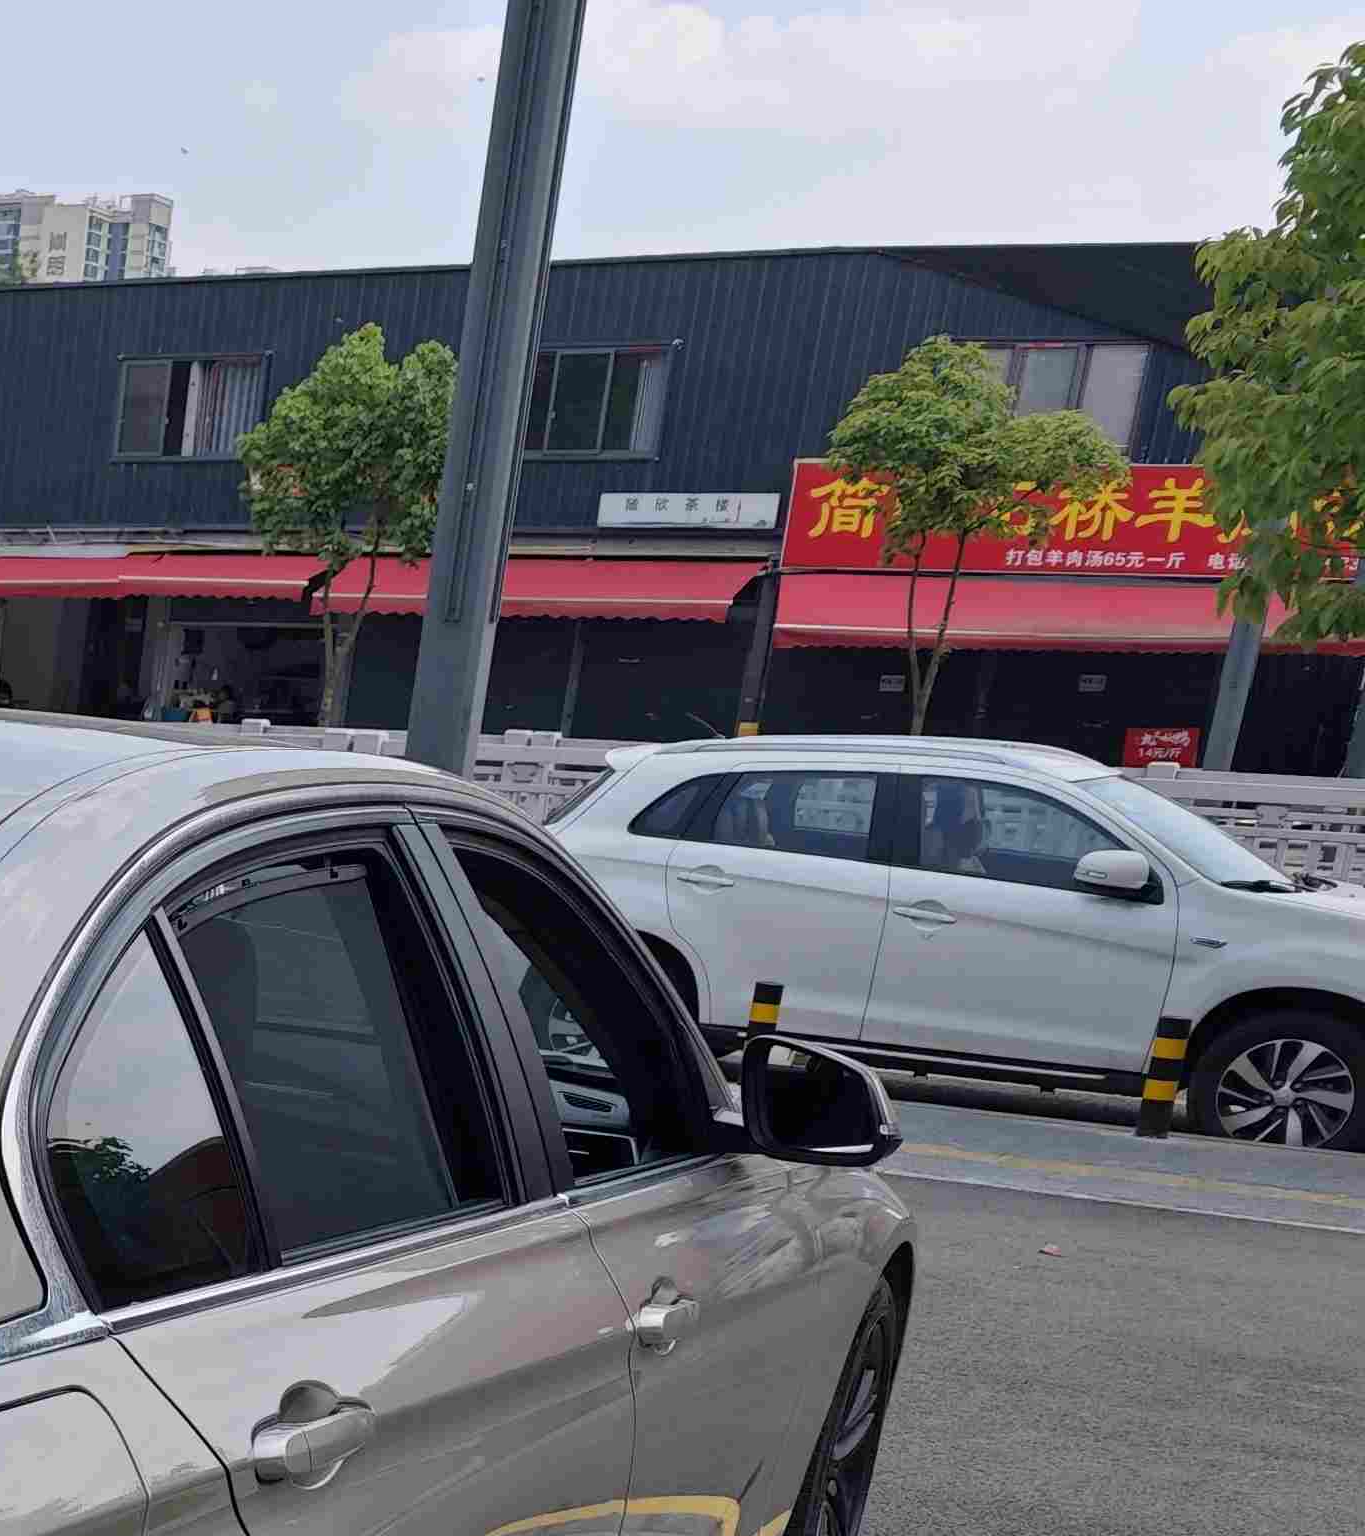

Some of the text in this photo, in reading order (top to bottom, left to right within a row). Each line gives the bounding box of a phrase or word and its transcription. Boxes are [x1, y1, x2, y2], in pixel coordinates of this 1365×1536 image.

[1005, 549, 1186, 570] 打包羊肉汤65元一斤
